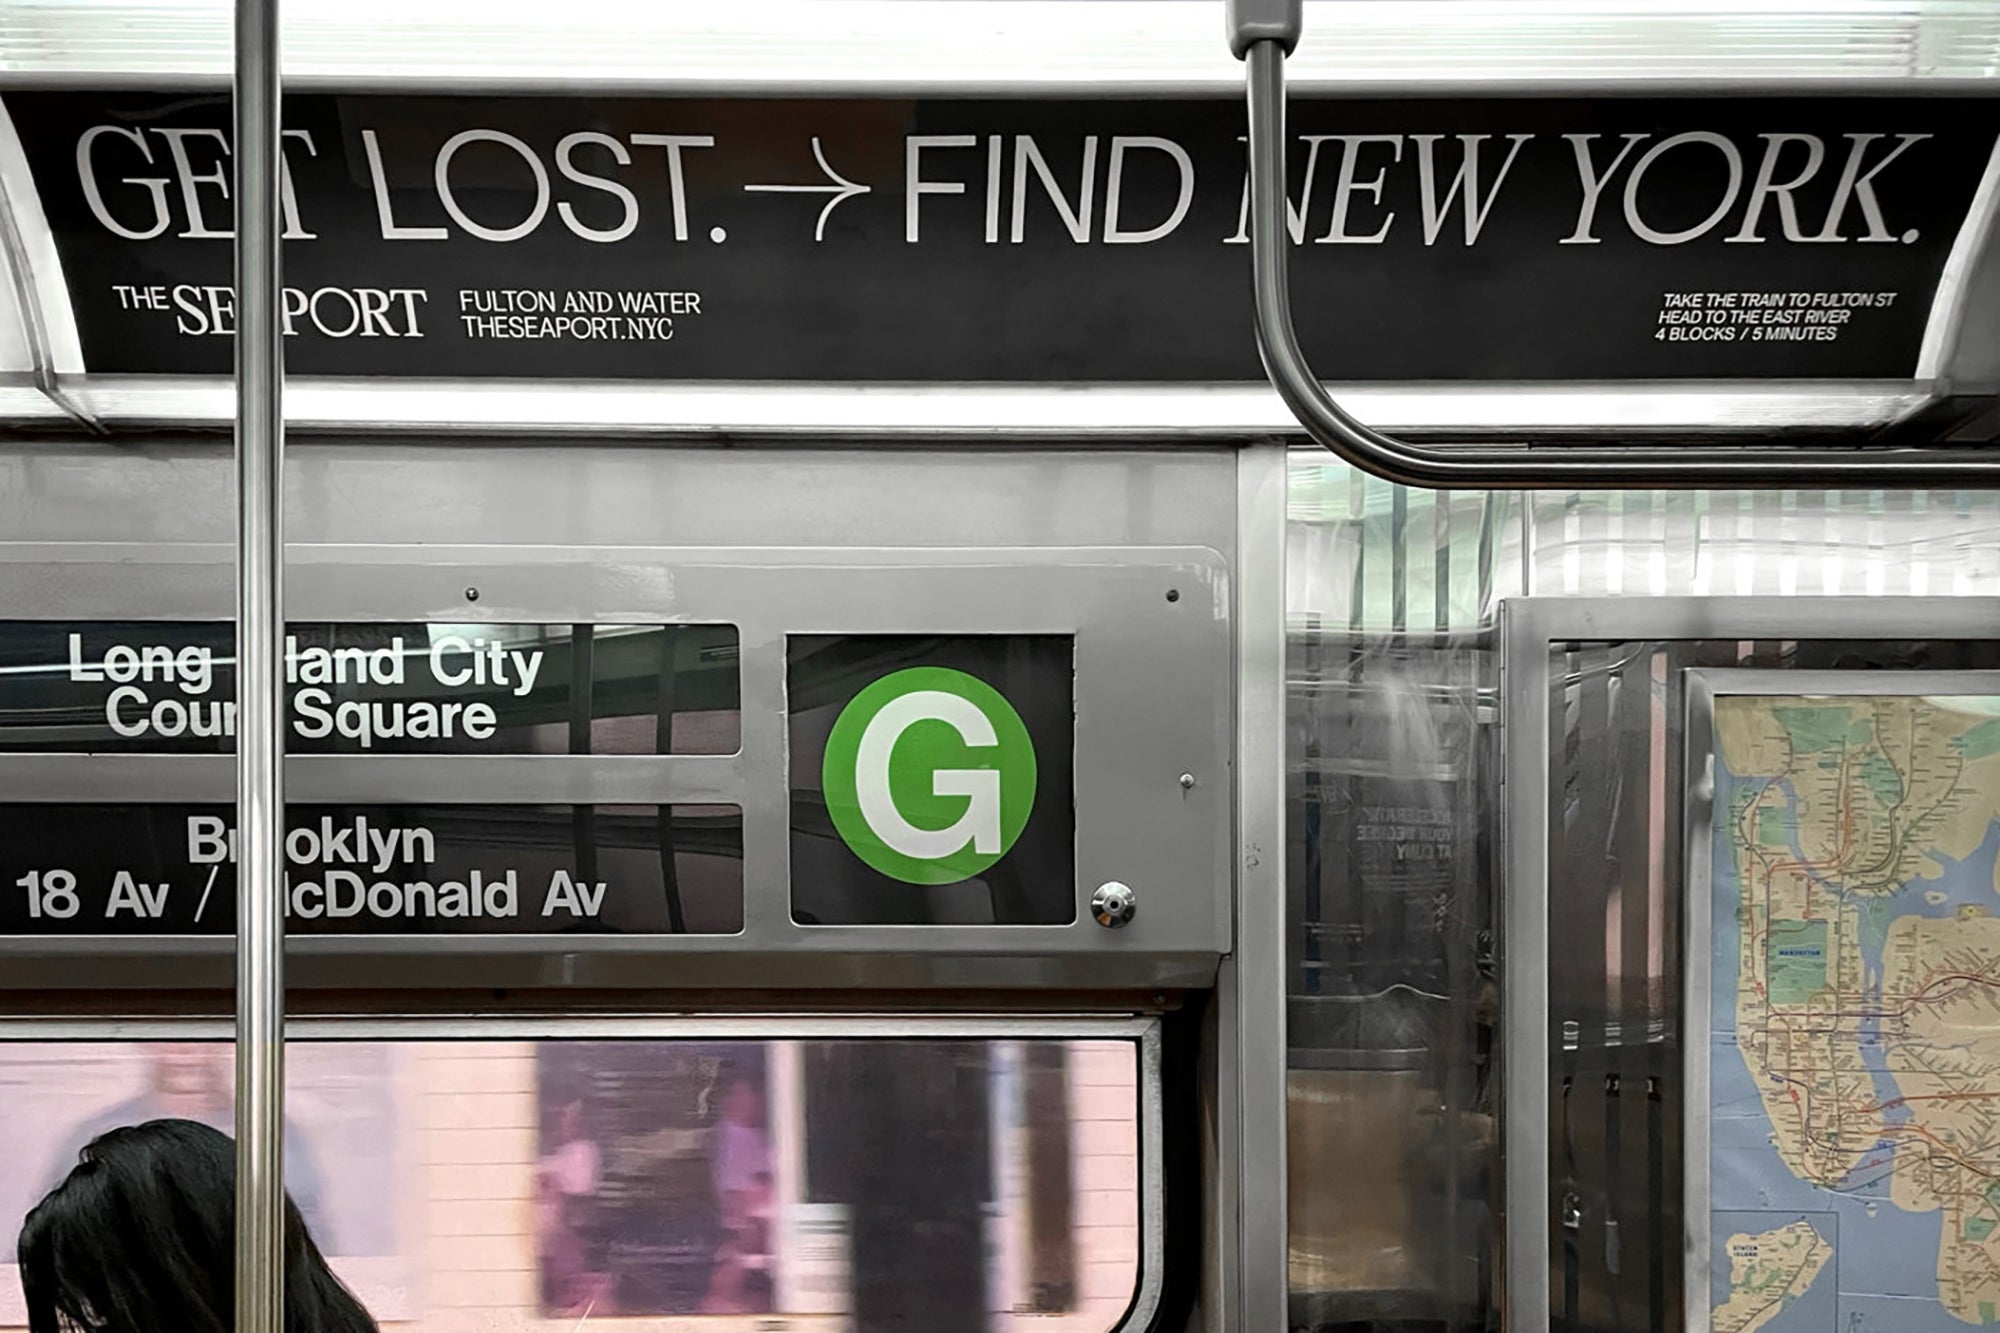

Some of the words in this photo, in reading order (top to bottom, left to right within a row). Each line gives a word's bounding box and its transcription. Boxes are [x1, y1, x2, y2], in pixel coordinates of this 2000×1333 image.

[77, 125, 317, 239] GET
[361, 129, 727, 242] LOST.
[906, 135, 1195, 244] FIND
[1223, 134, 1535, 246] NEW
[1558, 131, 1935, 245] YORK.
[112, 285, 170, 309] THE
[172, 284, 428, 338] SEPORT
[459, 290, 556, 313] FULTON
[563, 291, 614, 313] AND
[617, 291, 701, 314] WATER
[1658, 310, 1702, 324] HEAD
[1705, 310, 1727, 324] TO
[1729, 310, 1761, 324] THE
[1761, 310, 1804, 324] EAST
[1804, 310, 1851, 324] RIVER
[1663, 293, 1703, 307] TAKE
[1706, 293, 1739, 307] THE
[1740, 293, 1787, 307] TRAIN
[1788, 293, 1812, 307] TO
[1810, 293, 1873, 307] FULTON
[1874, 292, 1898, 307] ST
[460, 315, 674, 340] THESEAPORT.NYC
[1654, 327, 1667, 341] 4
[1668, 327, 1736, 341] BLOCKS
[1738, 327, 1751, 341] /
[1751, 327, 1763, 341] 5
[1764, 327, 1838, 341] MINUTES
[69, 633, 212, 694] Long
[285, 635, 405, 685] land
[430, 637, 544, 696] City
[105, 685, 237, 738] Cour
[293, 687, 497, 748] Square
[855, 690, 1000, 859] G
[187, 816, 435, 873] Boklyn
[16, 870, 80, 918] 18
[105, 871, 170, 918] Av
[193, 864, 219, 923] /
[284, 869, 518, 918] cDonald
[541, 870, 607, 917] Av
